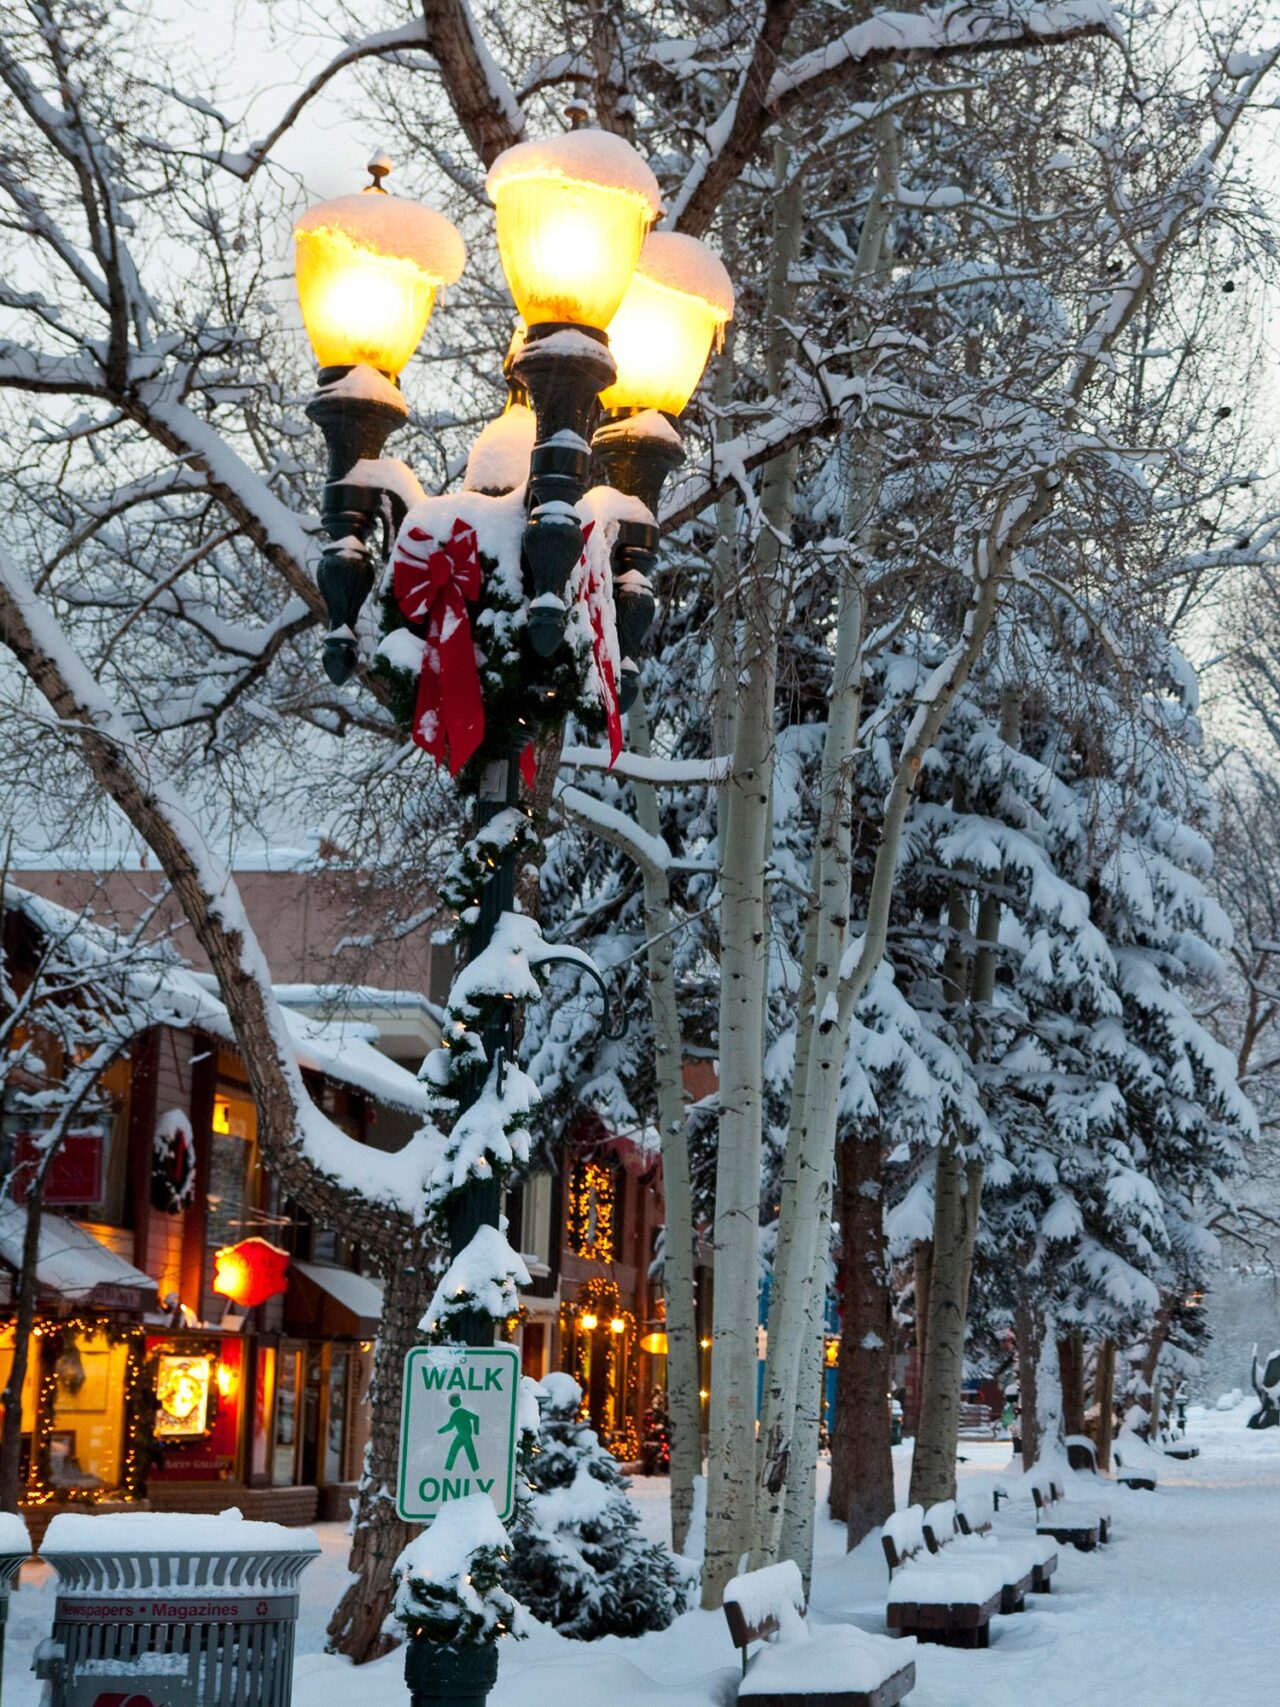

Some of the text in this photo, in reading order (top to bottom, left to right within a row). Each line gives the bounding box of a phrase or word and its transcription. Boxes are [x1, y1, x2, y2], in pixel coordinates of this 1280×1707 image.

[421, 1366, 504, 1391] WALK
[62, 1601, 239, 1619] Newspapers Magazines
